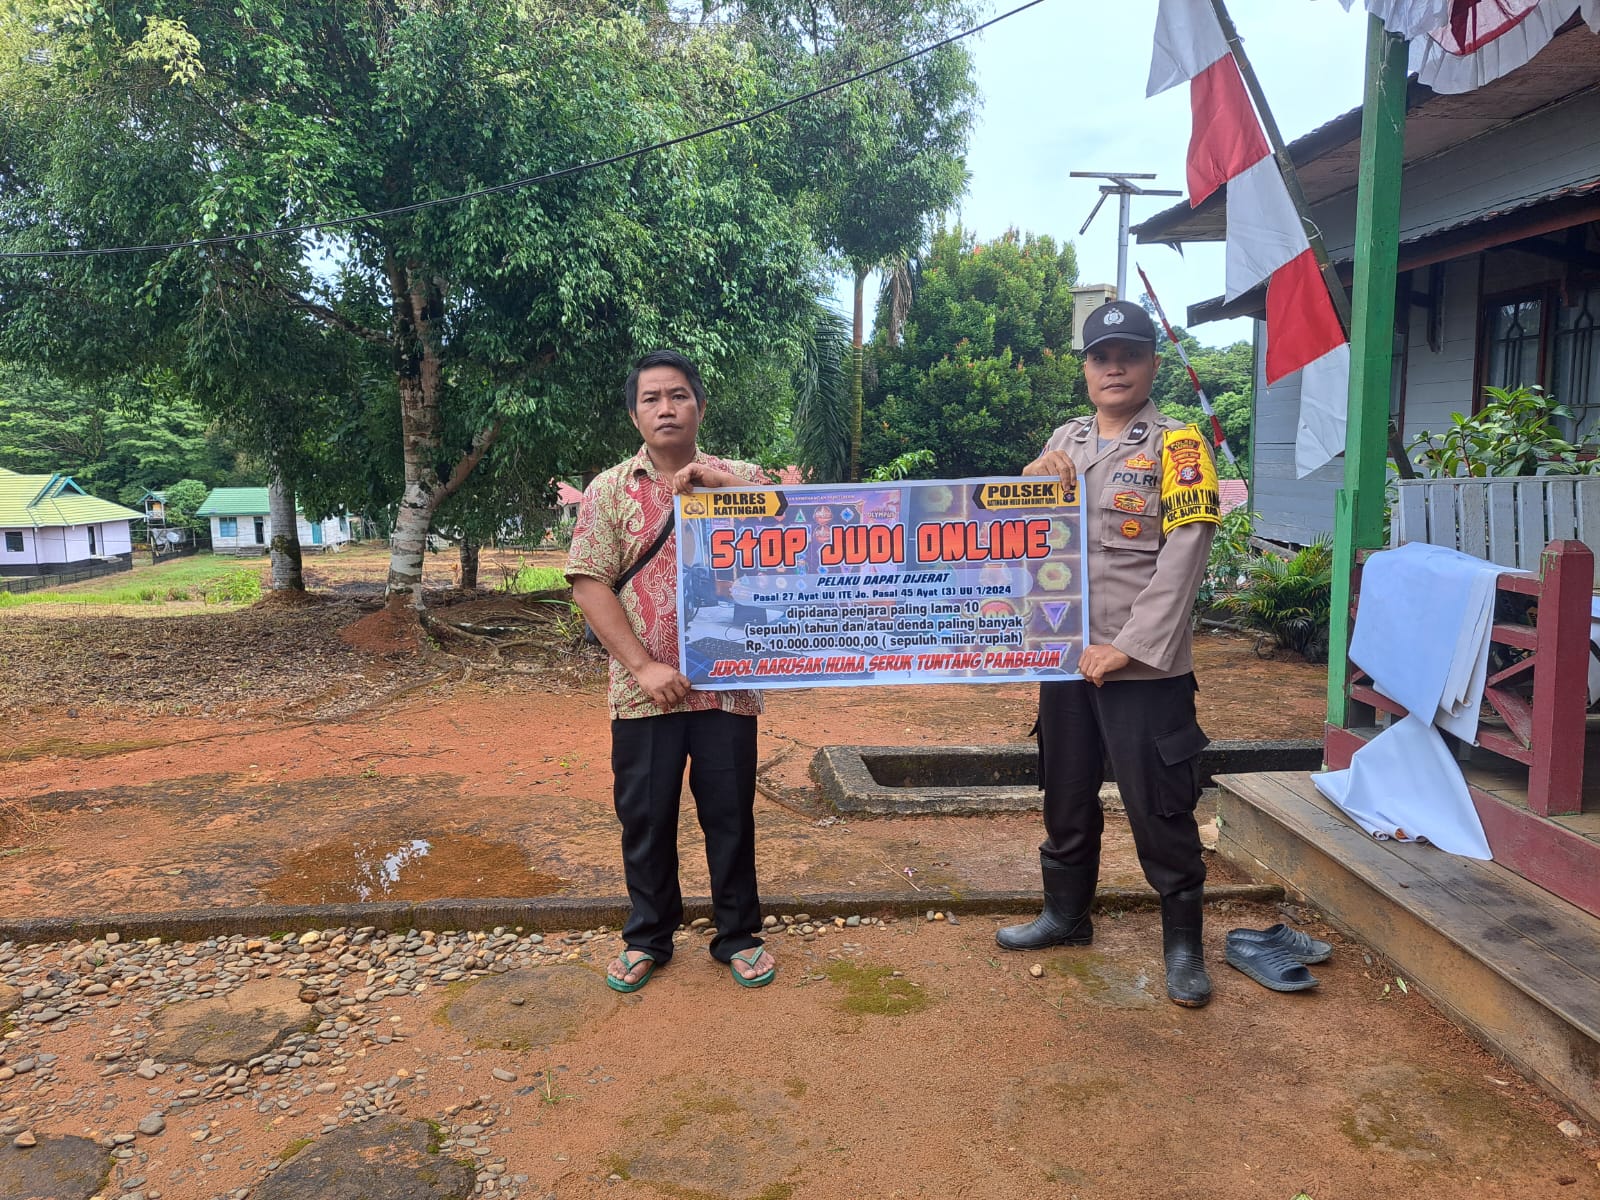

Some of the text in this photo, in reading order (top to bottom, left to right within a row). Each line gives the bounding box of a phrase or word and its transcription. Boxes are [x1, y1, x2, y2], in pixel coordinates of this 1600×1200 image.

[1112, 472, 1157, 487] POLRI
[713, 493, 766, 506] POLRES
[988, 484, 1054, 498] POLSEK
[713, 505, 766, 516] KATINGAN
[821, 524, 904, 566] JUDI
[917, 519, 1050, 562] ONLINE
[817, 573, 950, 587] PELAKU DAPAT DIJERAT
[753, 585, 1011, 602] Pasal 27 Ayat UU ITE Jo. Pasal 45 Ayat (3) UU 1/2024
[787, 602, 979, 620] dipidana penjara paling lama 10
[745, 616, 1022, 637] (sepuluh) tahun dan/atau denda paling banyak
[746, 640, 765, 653] Rp.
[770, 636, 878, 650] 10.000.000.000,00
[891, 634, 936, 648] sepuluh
[941, 633, 976, 645] miliar
[980, 632, 1023, 647] rupiah)
[709, 650, 1061, 678] JUDOL MARUSAK HUMA SERUK TUNTANG PAMBELUM
